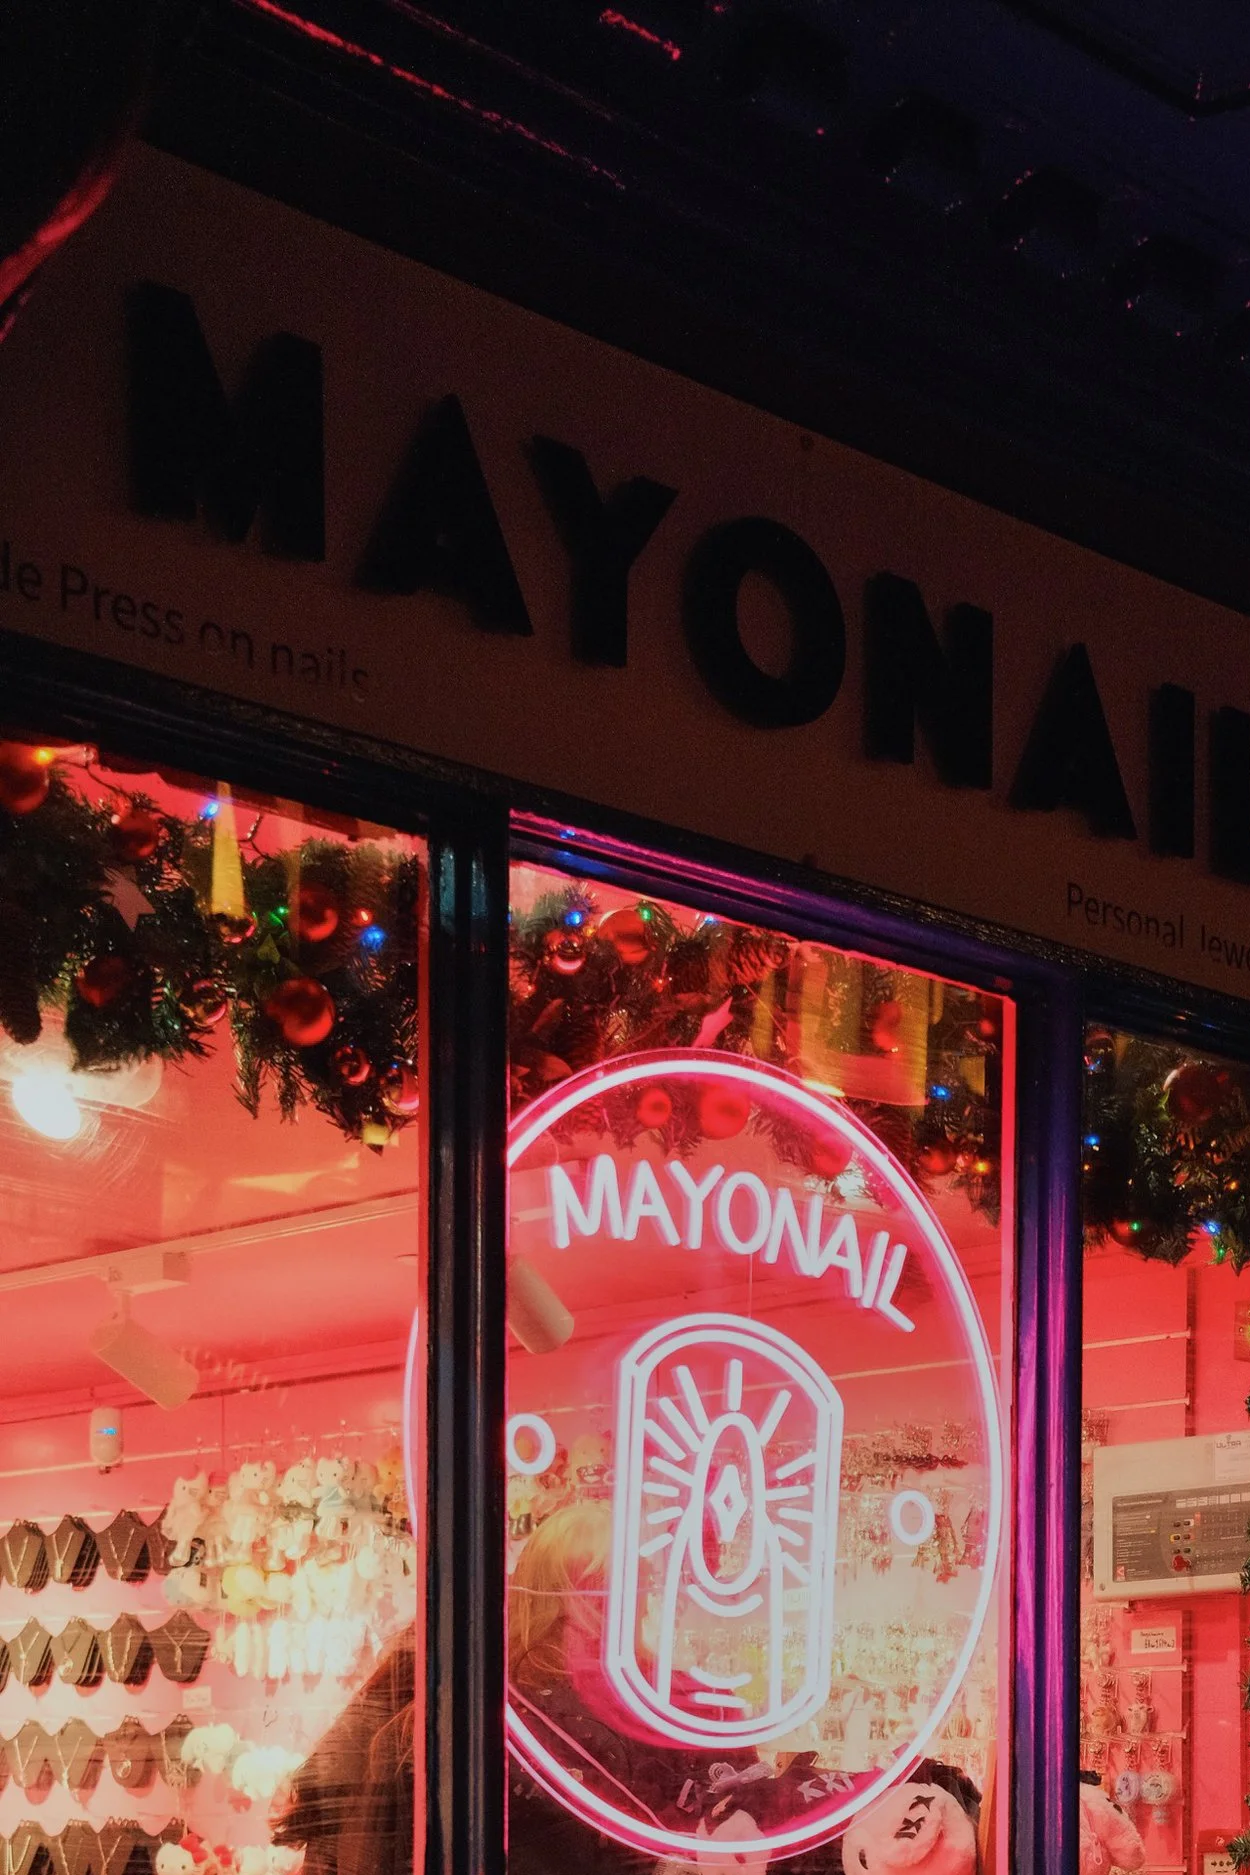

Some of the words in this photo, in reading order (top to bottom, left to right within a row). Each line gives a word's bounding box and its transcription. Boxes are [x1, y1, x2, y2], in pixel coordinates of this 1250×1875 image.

[61, 563, 184, 645] Press
[199, 620, 255, 668] on
[271, 642, 369, 703] nails
[1066, 882, 1184, 950] Personal
[546, 1152, 917, 1334] MAYONAIL
